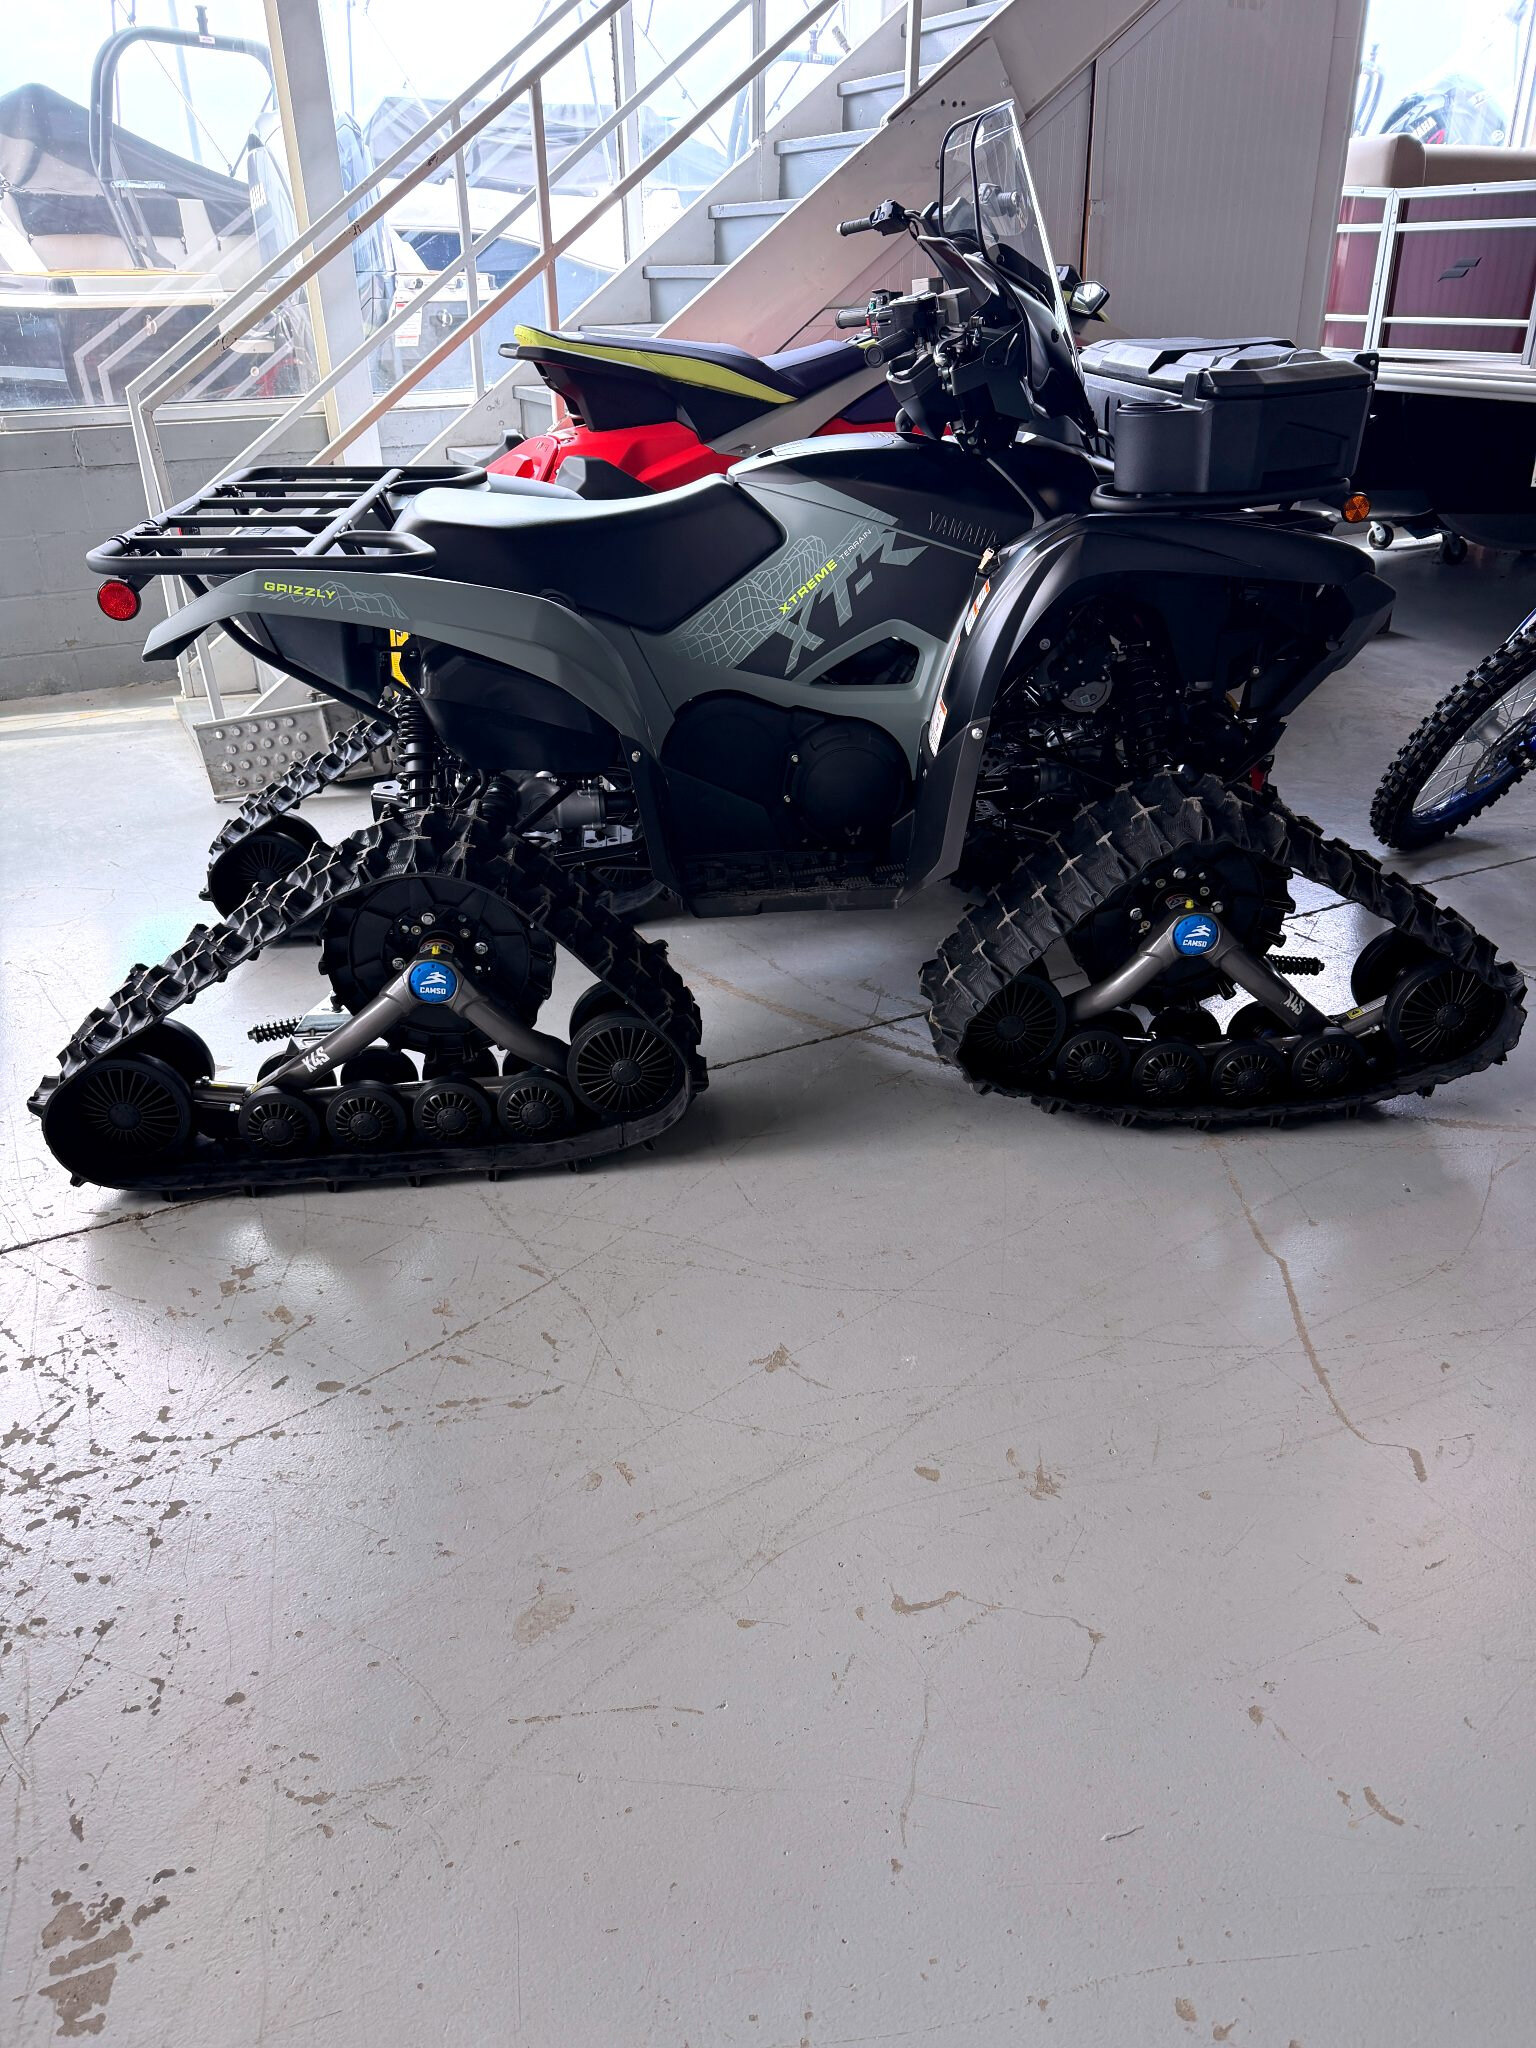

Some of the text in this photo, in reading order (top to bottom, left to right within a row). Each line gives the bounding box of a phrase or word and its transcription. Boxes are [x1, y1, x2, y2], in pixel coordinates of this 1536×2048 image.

[929, 511, 998, 548] YAMAHA
[778, 528, 872, 615] XTREME TERRAIN
[263, 581, 336, 600] GRIZZLY
[1182, 939, 1208, 948] CAMSO
[419, 986, 447, 995] CAMSO
